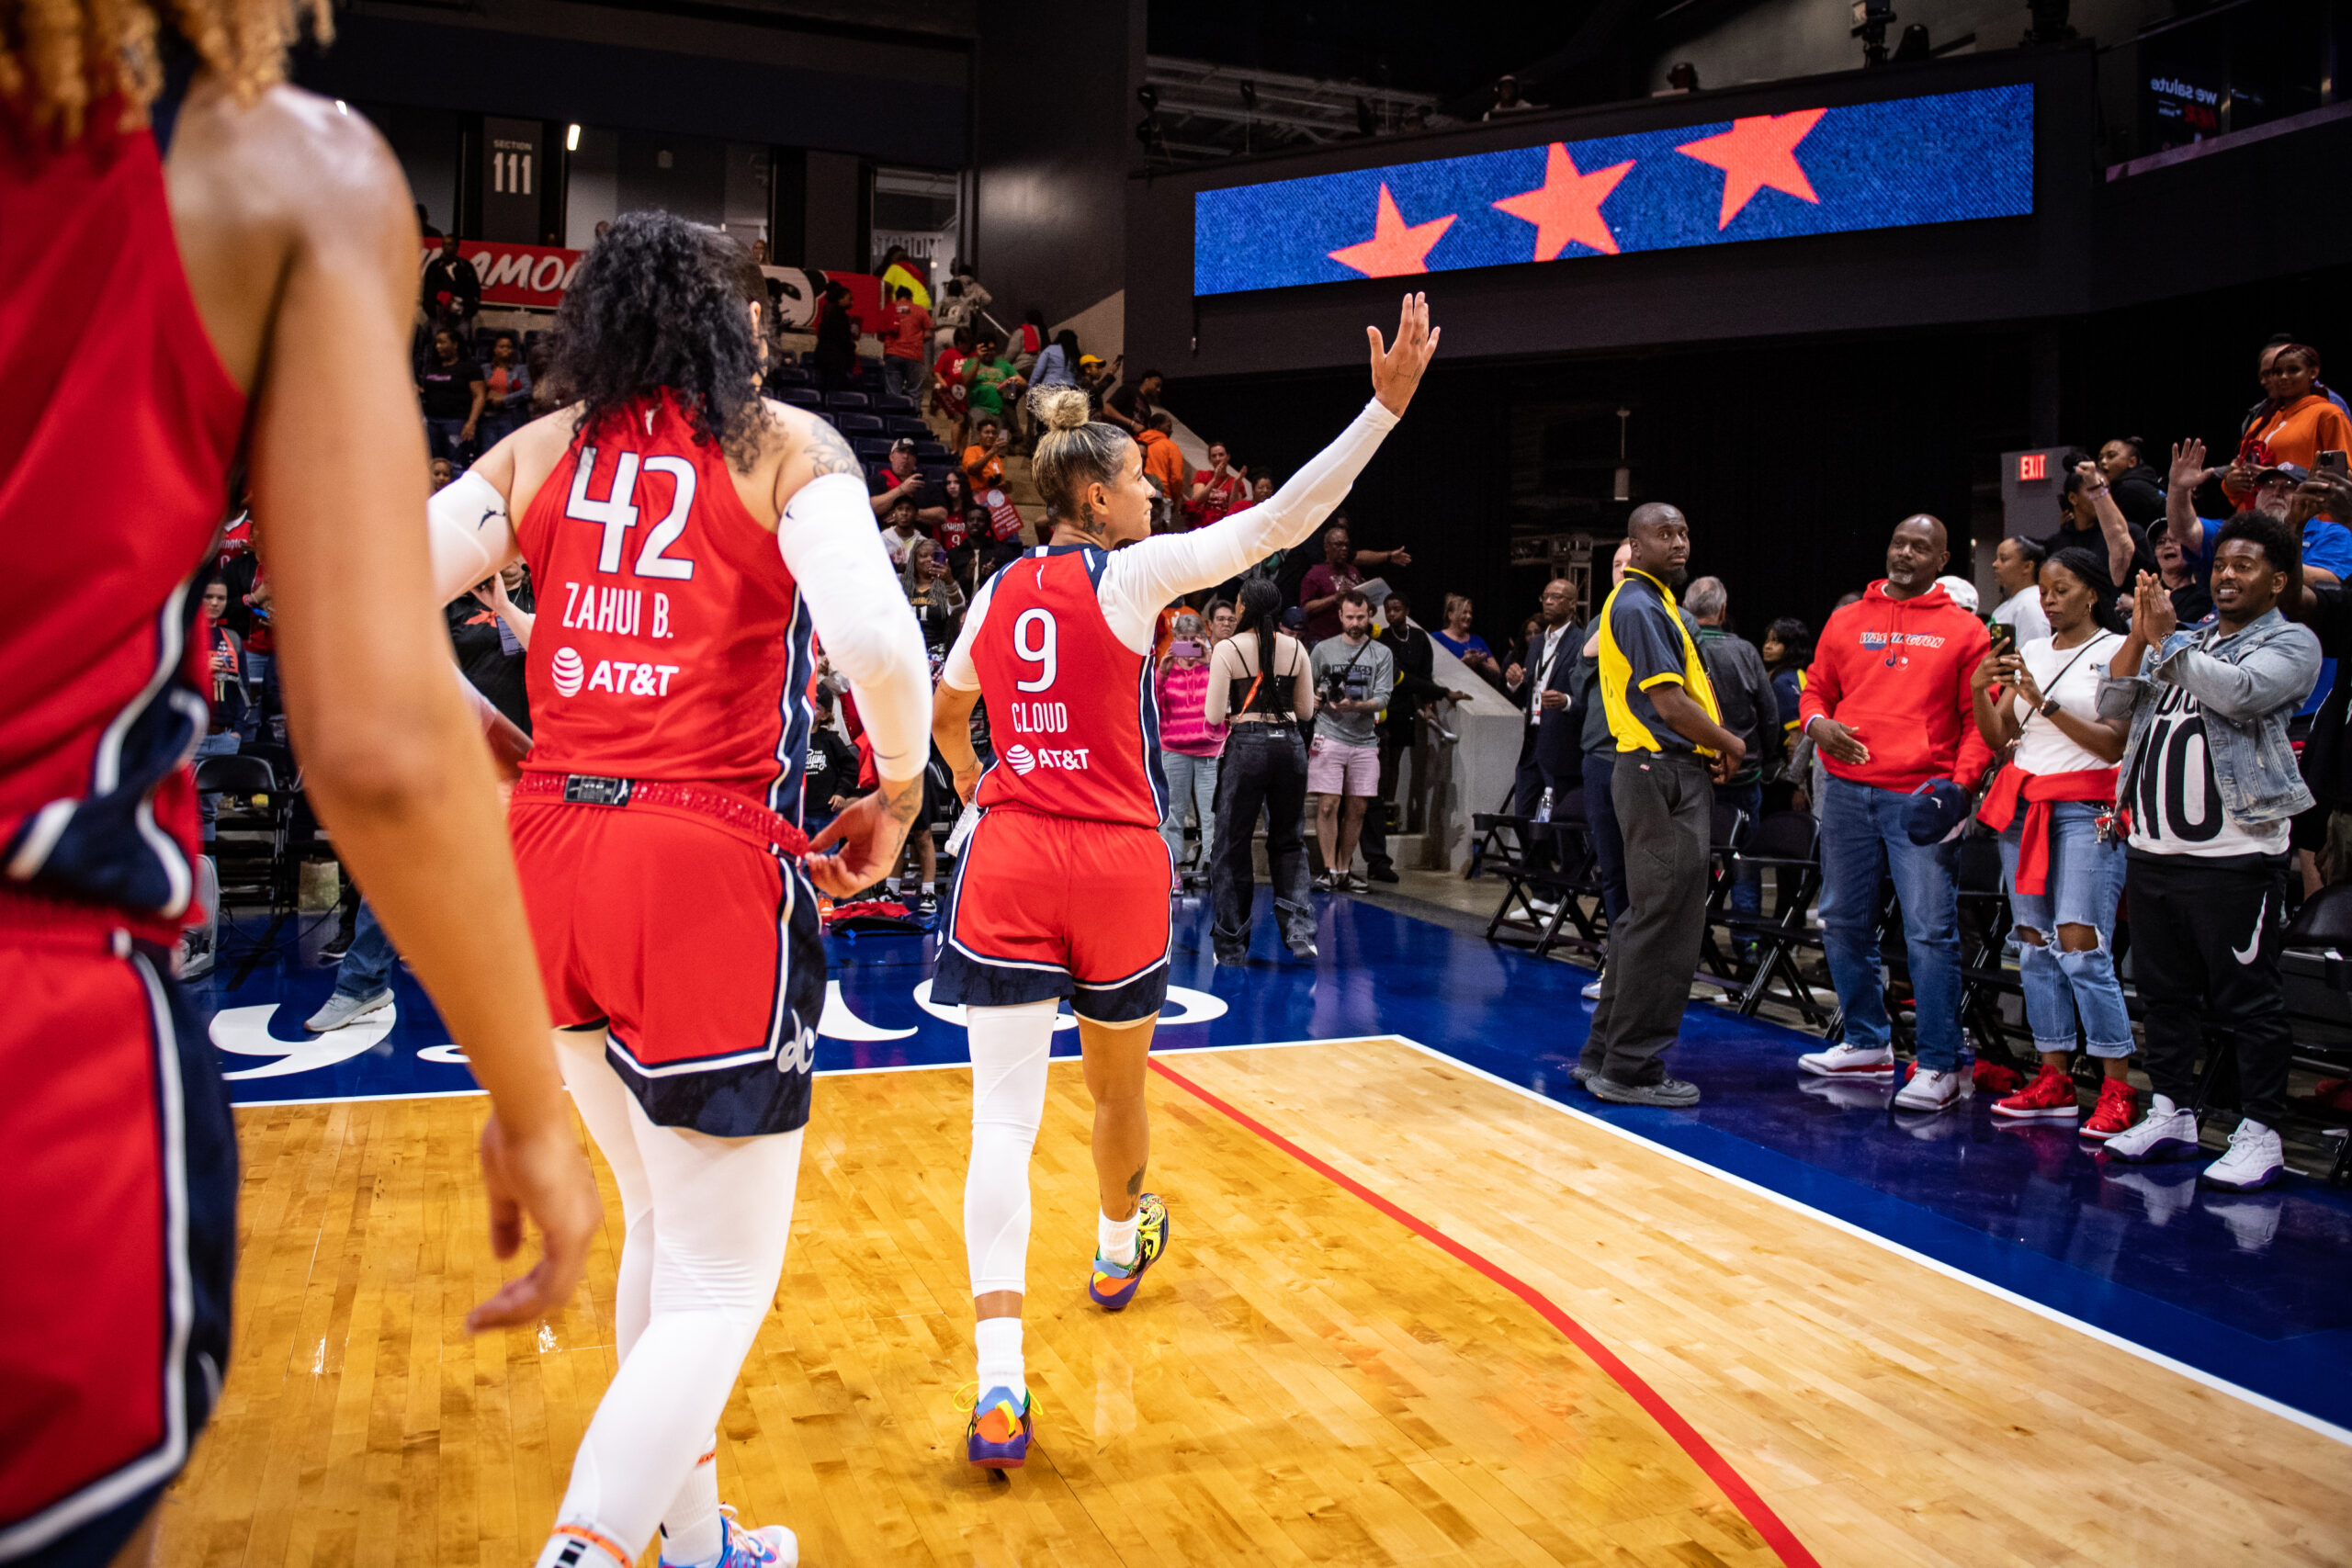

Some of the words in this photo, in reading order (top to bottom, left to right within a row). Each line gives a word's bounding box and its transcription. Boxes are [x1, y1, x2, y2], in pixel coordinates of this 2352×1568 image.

[492, 139, 533, 151] SECTION
[492, 152, 533, 195] 111
[2019, 454, 2046, 480] EXIT
[566, 446, 696, 581] 42
[562, 581, 642, 636] ZAHUI
[652, 592, 674, 638] B.
[1013, 607, 1057, 694] 9
[588, 660, 679, 698] AT&T
[1012, 702, 1069, 734] CLOUD
[1039, 749, 1090, 772] AT&T
